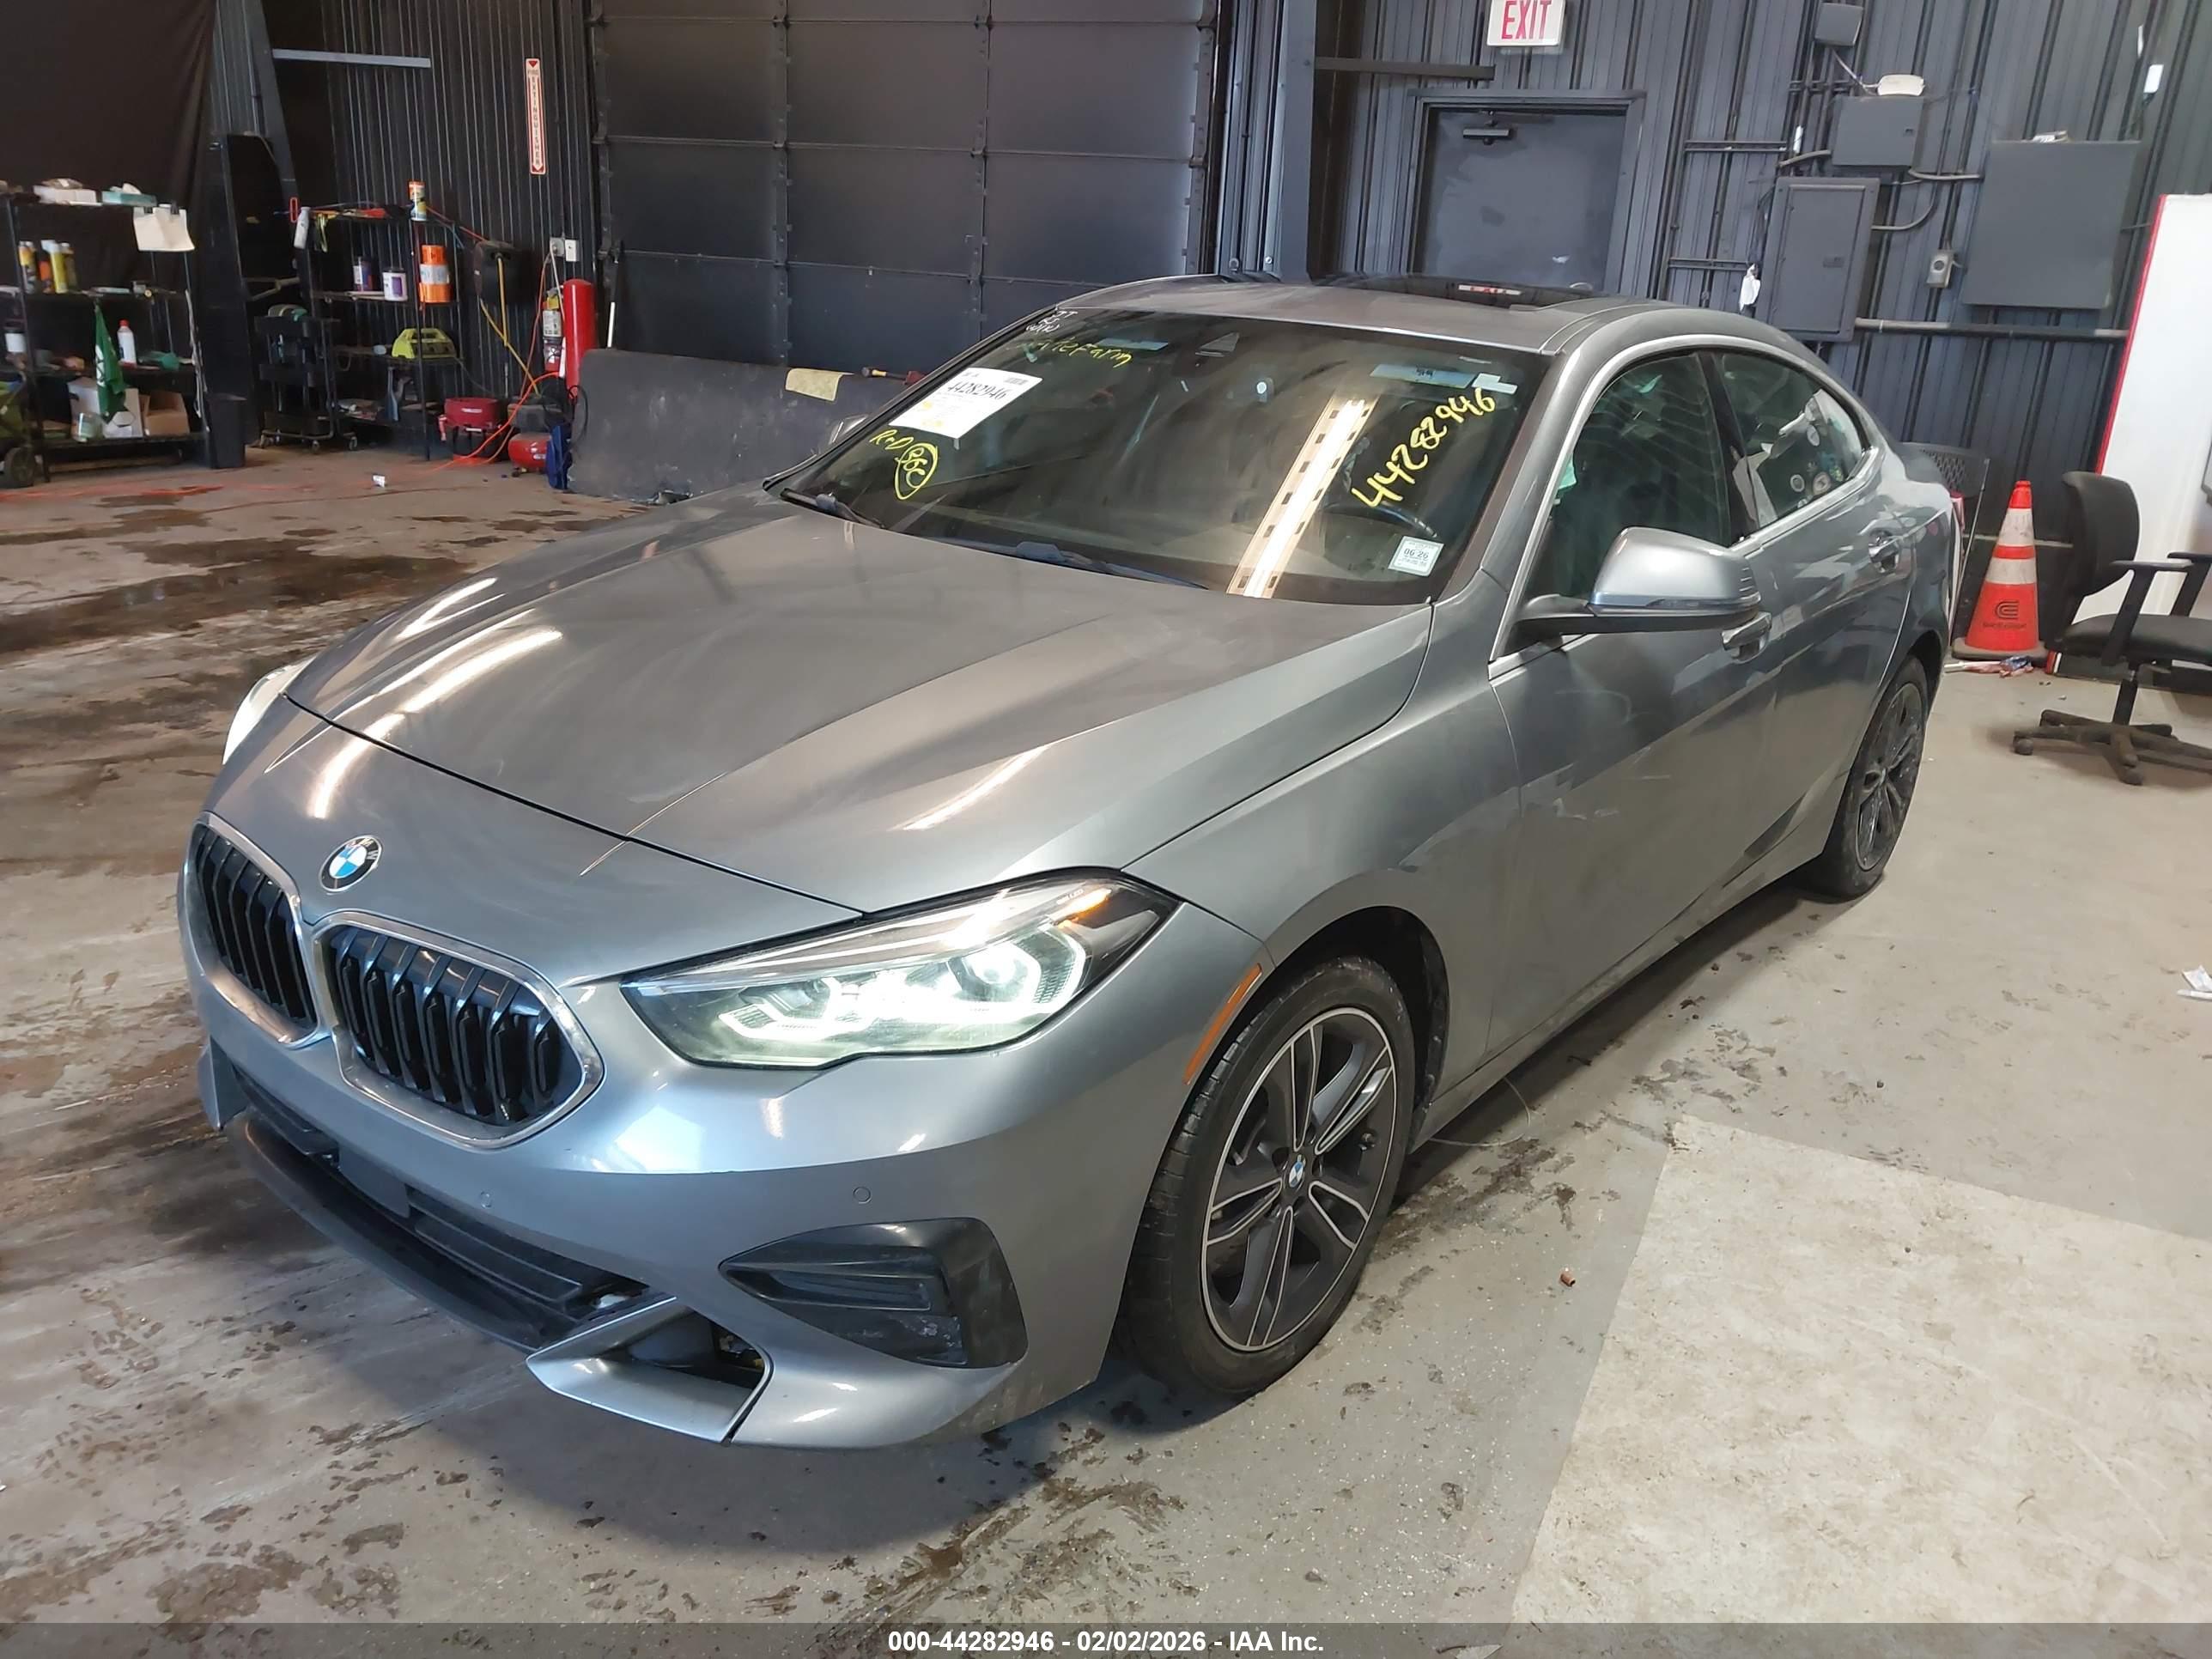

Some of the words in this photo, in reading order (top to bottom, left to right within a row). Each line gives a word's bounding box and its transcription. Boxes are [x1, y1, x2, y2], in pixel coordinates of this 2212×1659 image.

[1501, 0, 1552, 40] EXIT
[532, 76, 540, 164] EXTINGUISHER
[947, 380, 1012, 400] 44282946
[1351, 387, 1496, 507] 44282946
